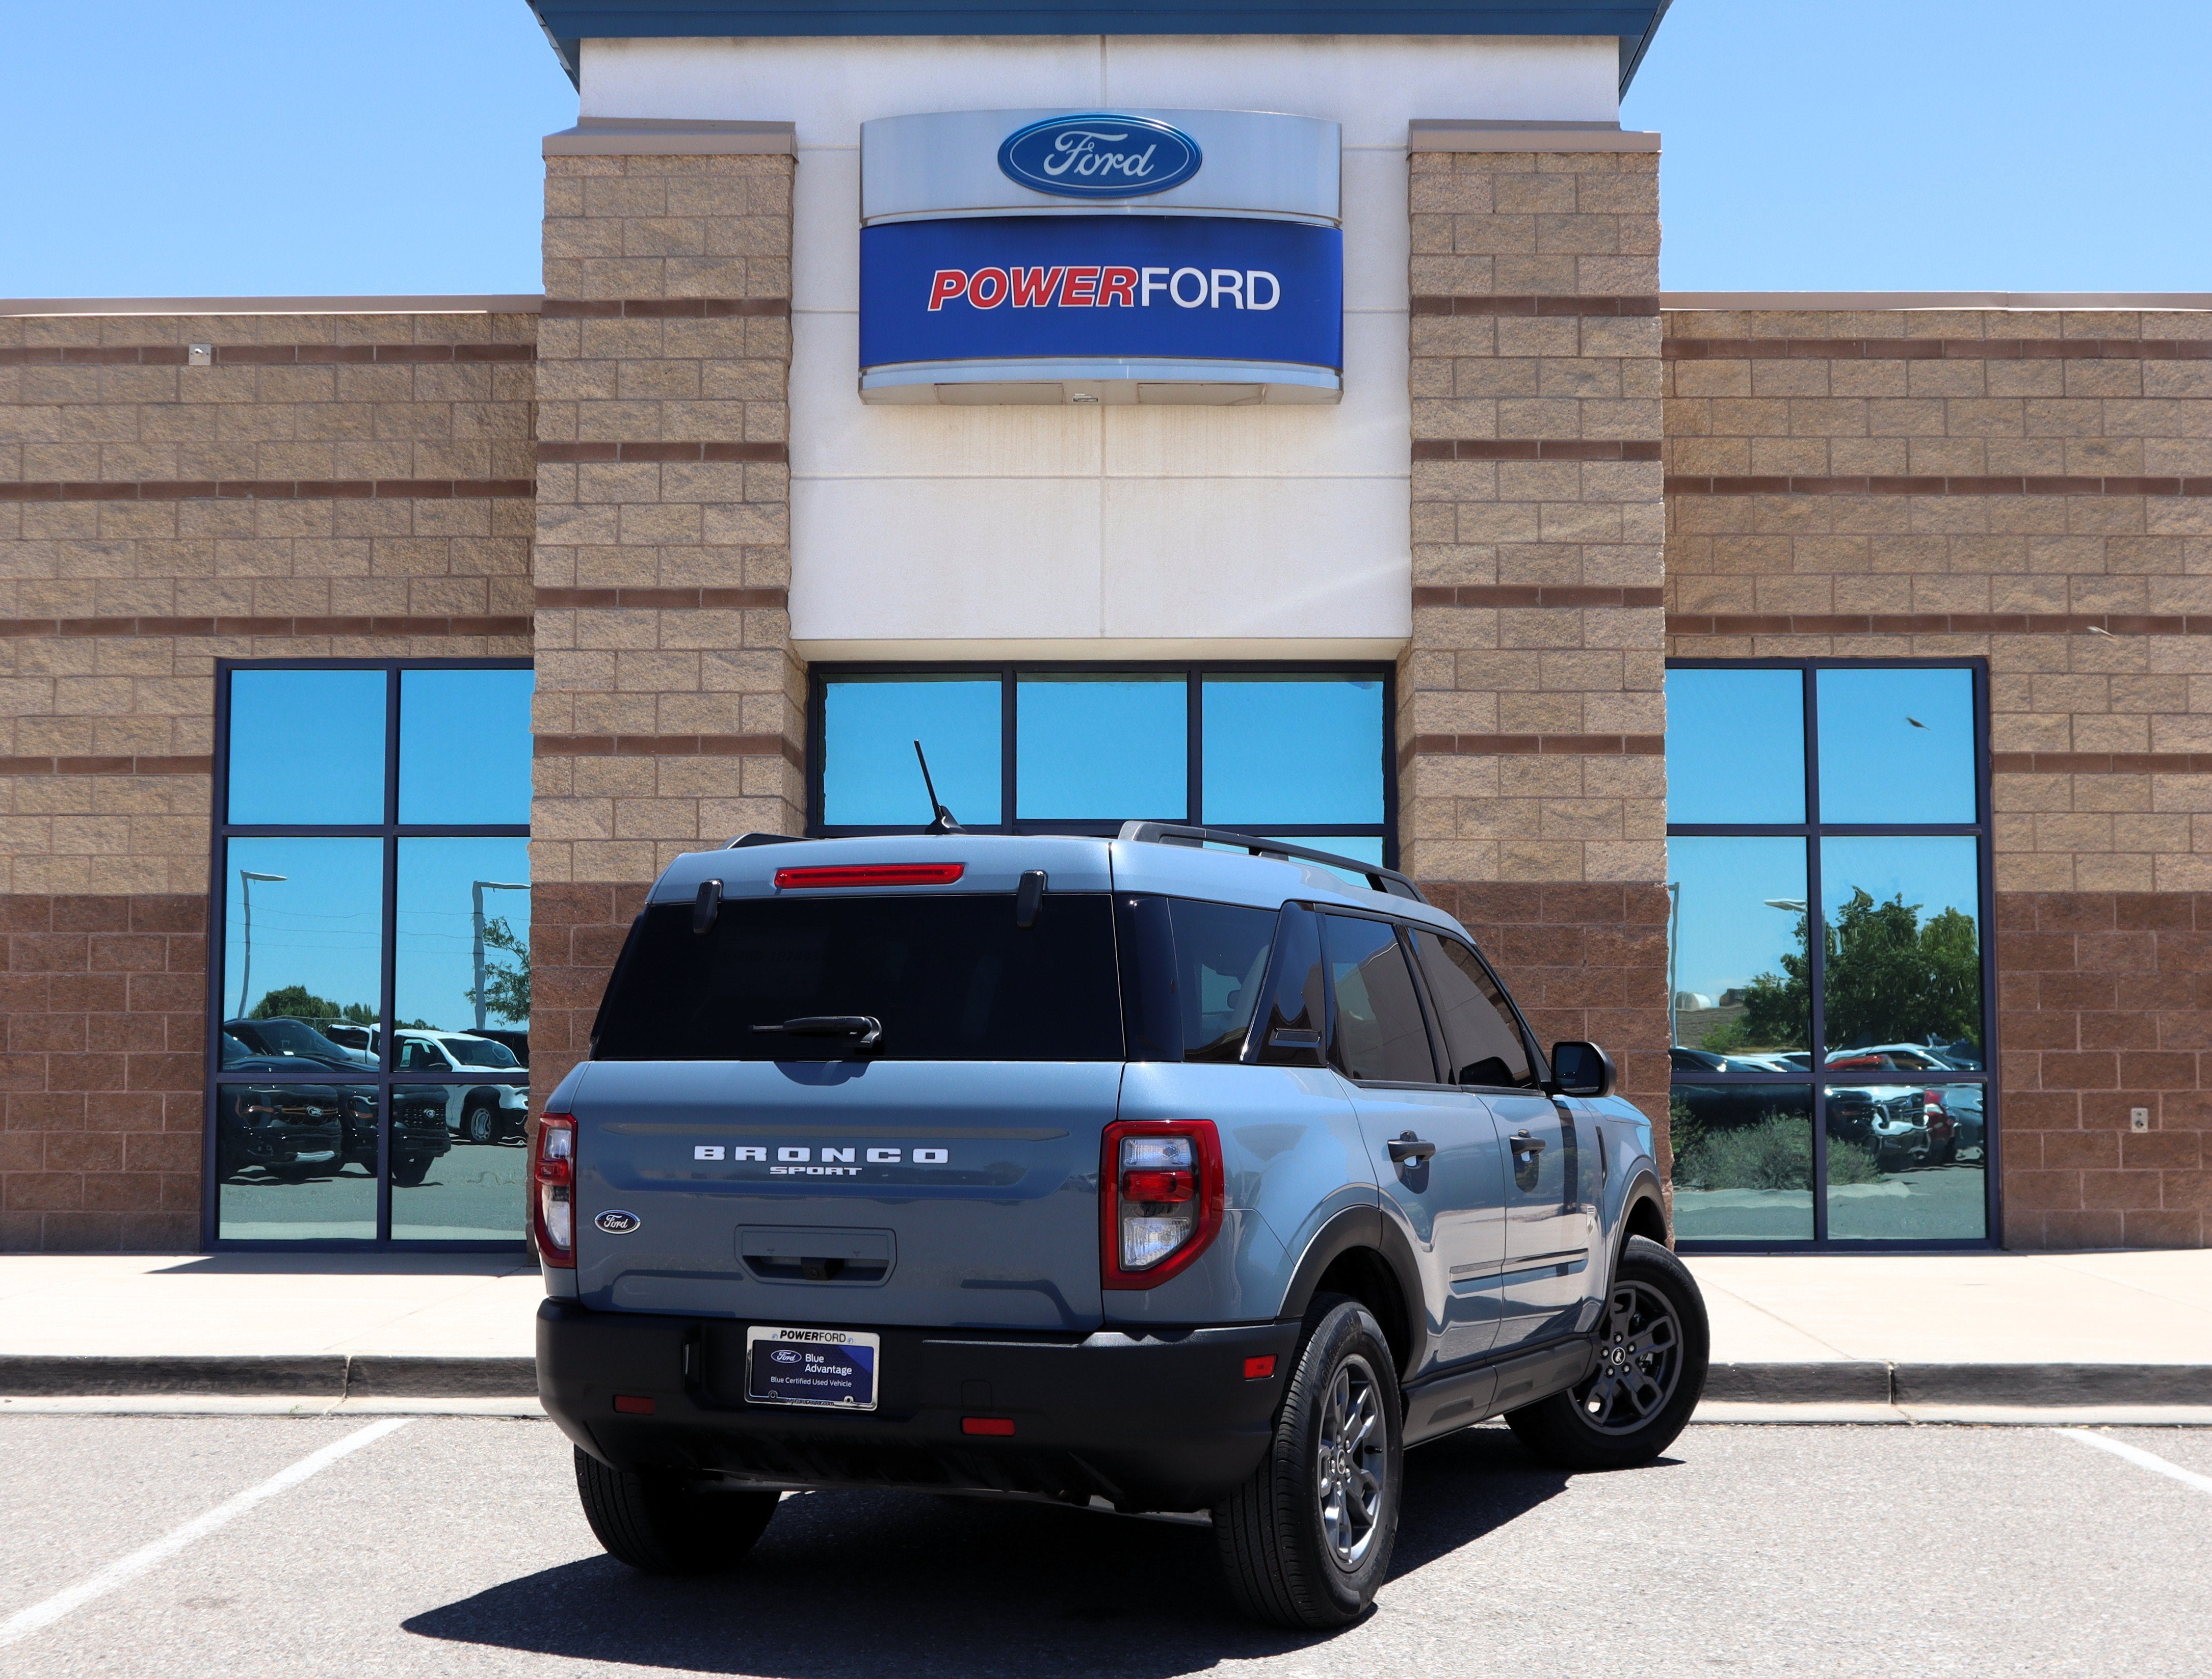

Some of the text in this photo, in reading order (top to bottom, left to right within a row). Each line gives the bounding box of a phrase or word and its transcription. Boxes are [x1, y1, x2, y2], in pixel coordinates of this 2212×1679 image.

[1043, 130, 1156, 176] Ford
[928, 266, 1280, 311] POWERFORD
[694, 1145, 949, 1164] BRONCO
[770, 1166, 862, 1176] SPORT
[604, 1214, 628, 1229] Ford
[780, 1330, 846, 1343] POWERFORD
[777, 1351, 796, 1362] Ford
[805, 1353, 824, 1363] Blue
[805, 1364, 852, 1376] Advantage
[785, 1377, 811, 1385] Certified
[829, 1379, 852, 1388] Vehicle
